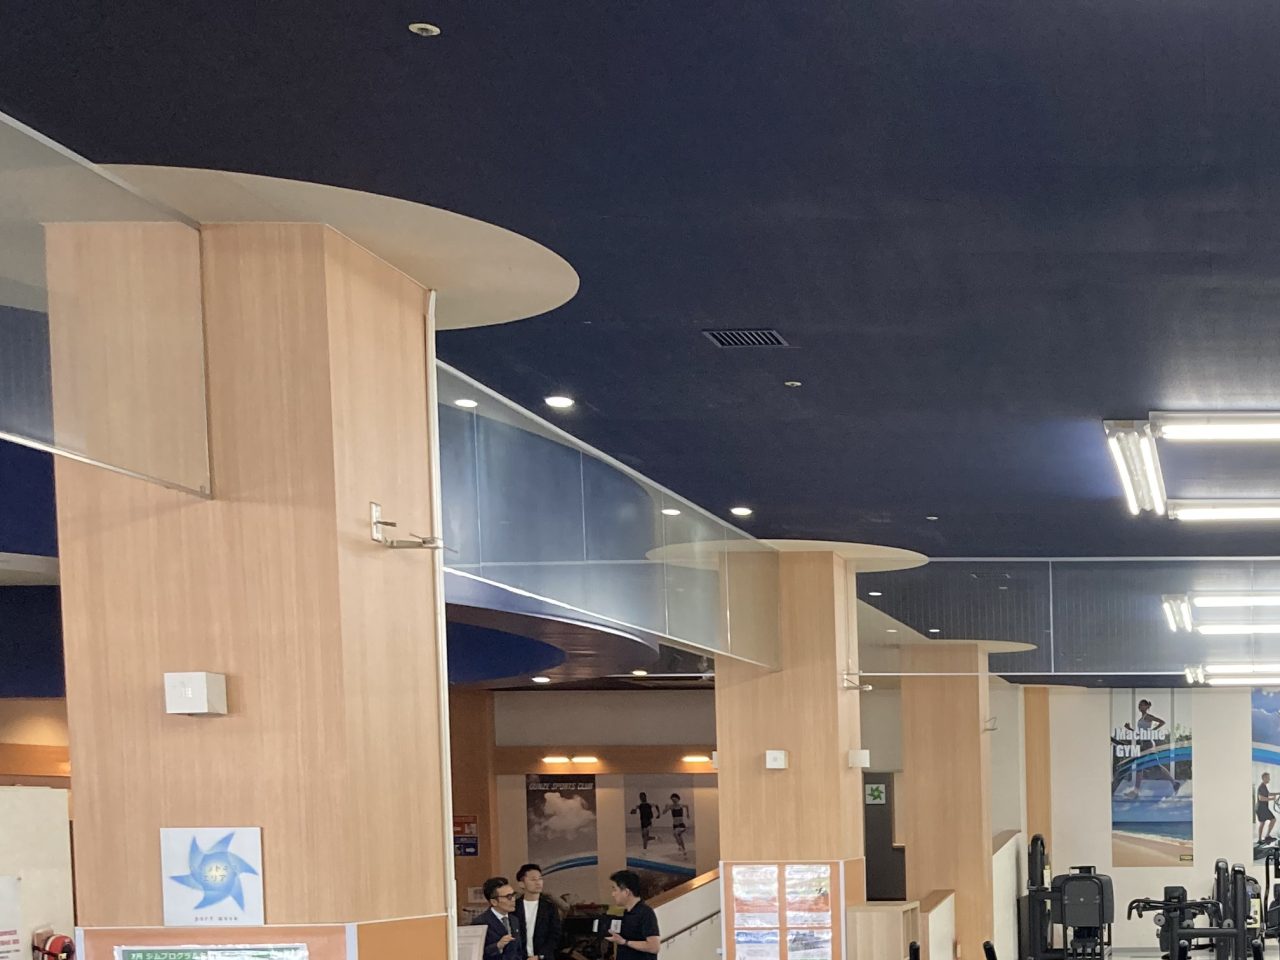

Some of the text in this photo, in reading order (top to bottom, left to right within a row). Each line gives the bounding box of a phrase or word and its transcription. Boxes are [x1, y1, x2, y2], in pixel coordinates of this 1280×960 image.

[1116, 727, 1166, 740] Machine
[1115, 745, 1141, 757] GYM
[551, 782, 577, 790] SPORTS
